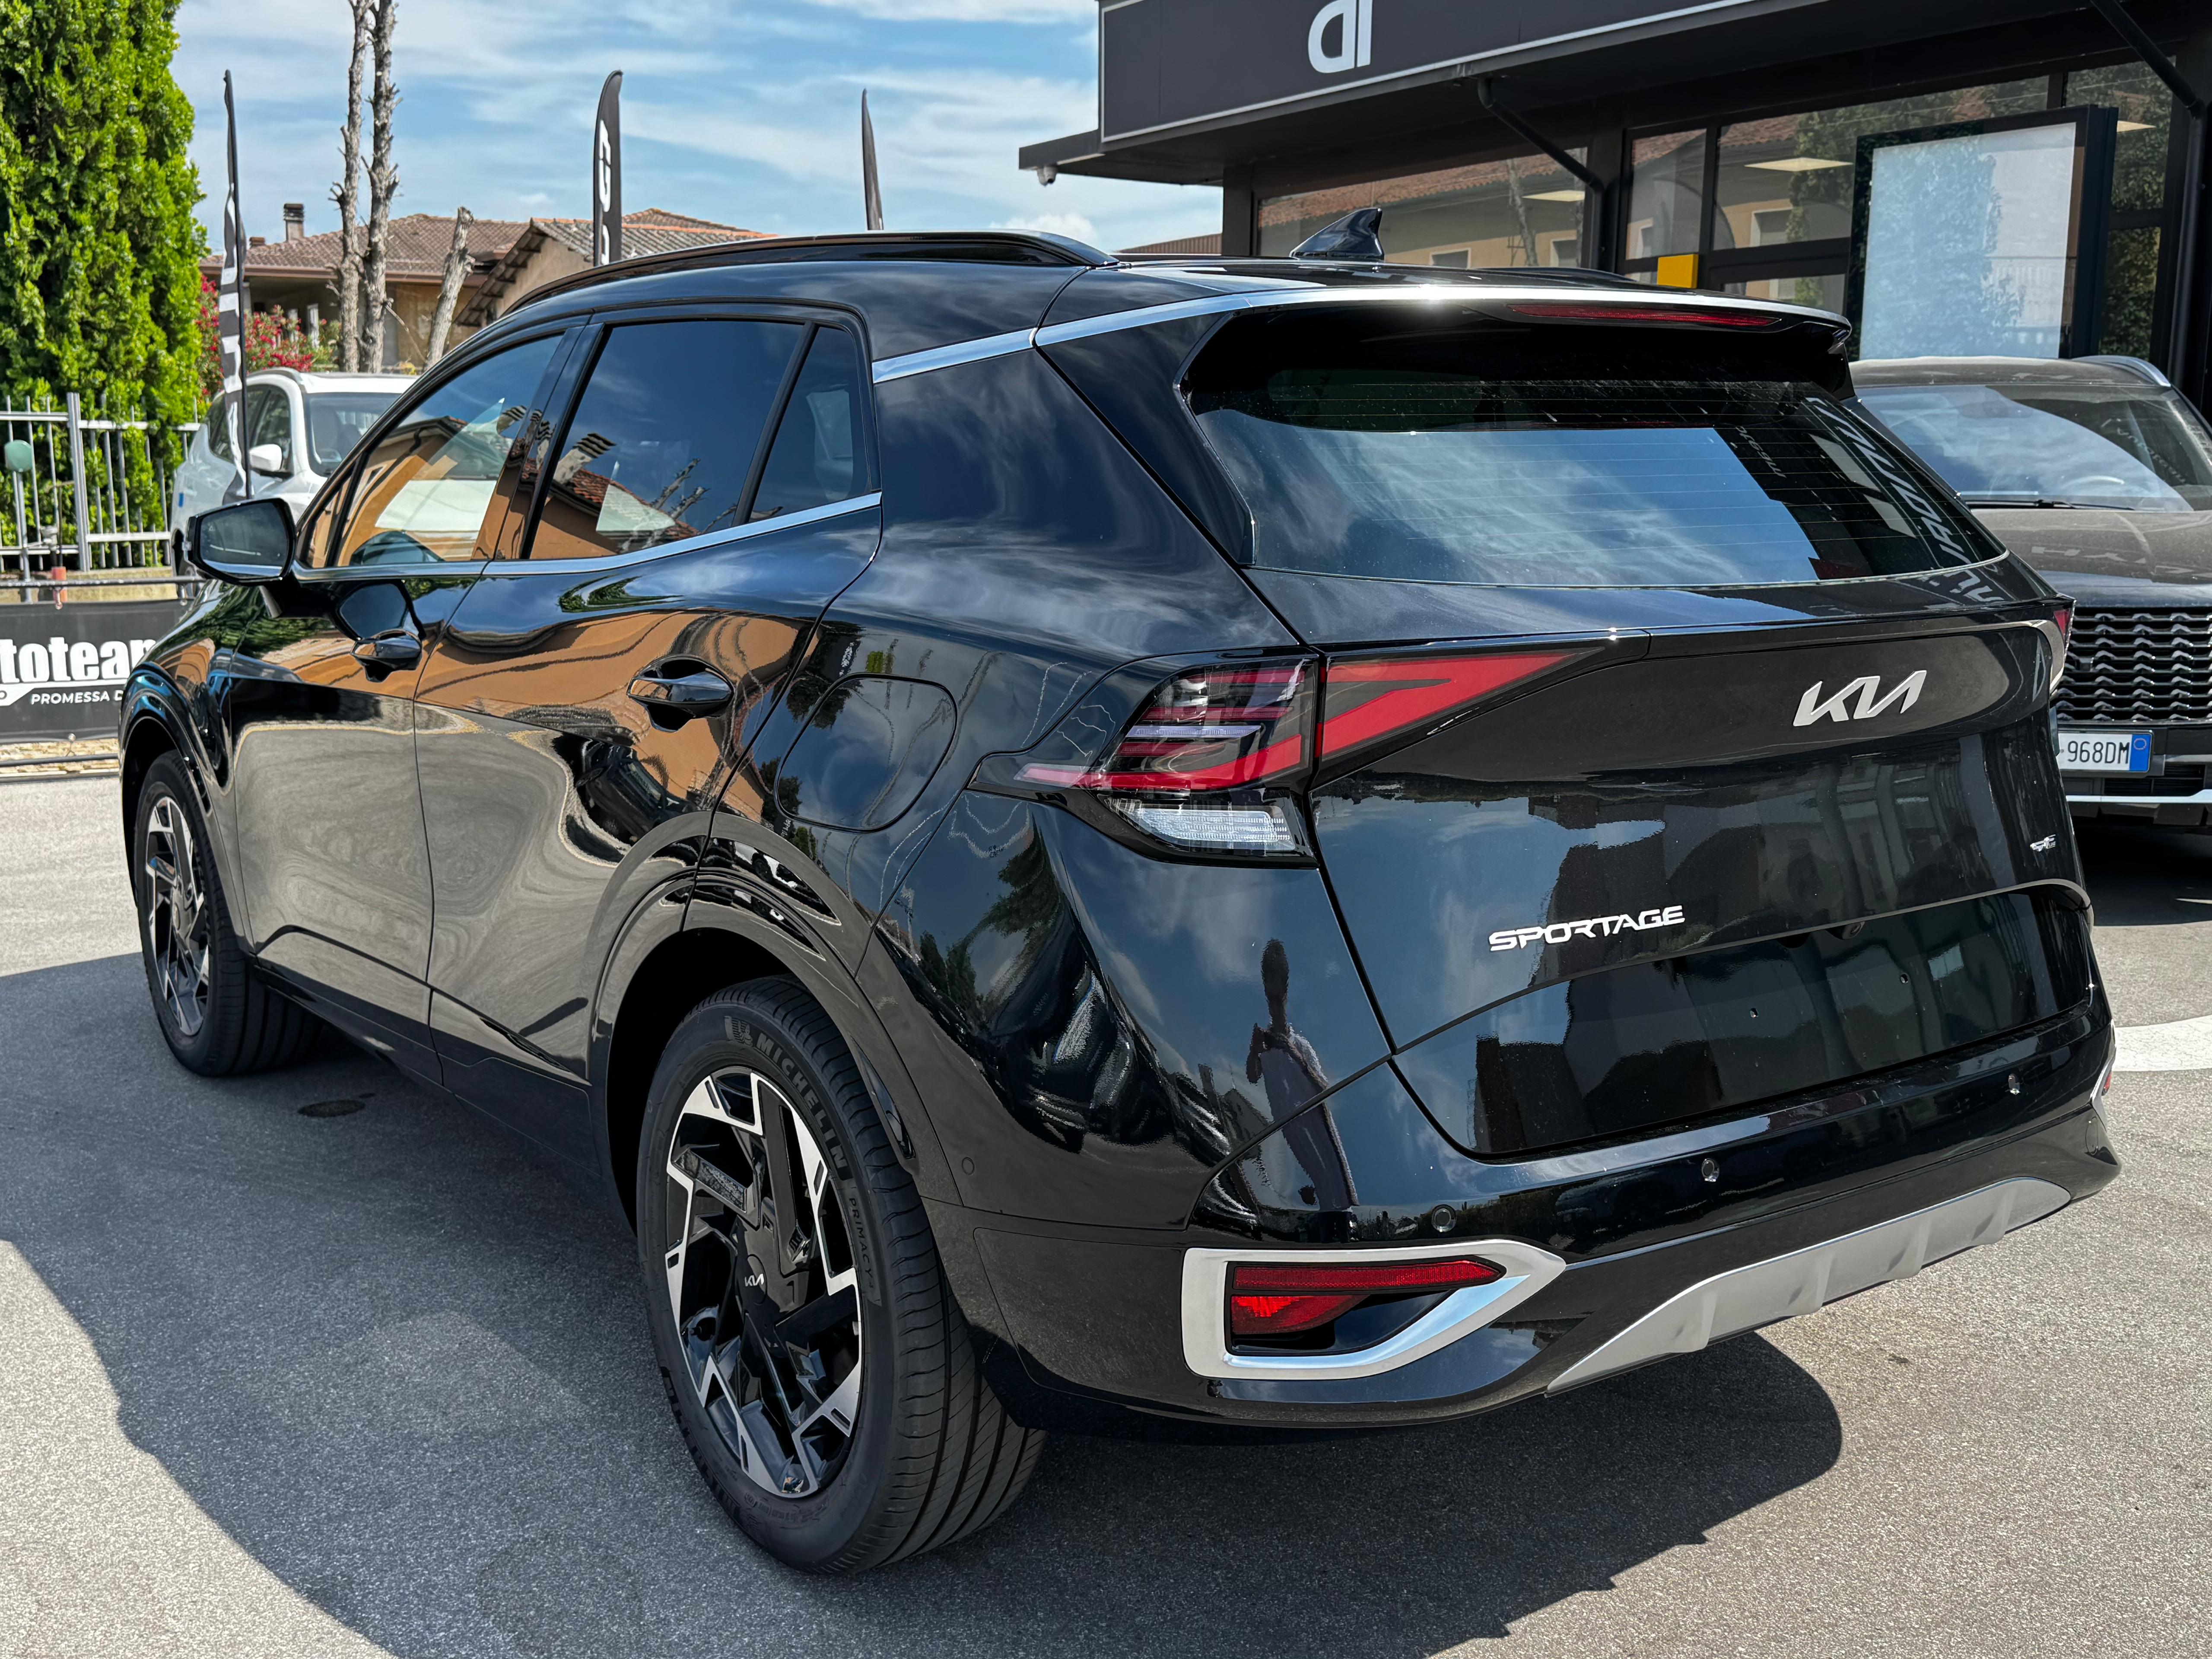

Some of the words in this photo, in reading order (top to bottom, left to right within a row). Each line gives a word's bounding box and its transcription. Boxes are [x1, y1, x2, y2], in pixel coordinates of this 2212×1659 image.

[31, 691, 110, 705] PROMESSA
[1793, 670, 1927, 727] KIA
[2067, 741, 2130, 764] 968DM
[1488, 905, 1685, 951] SPORTAGE
[756, 1032, 849, 1169] MICHELIN
[849, 1198, 873, 1278] PRIMACY
[744, 1273, 765, 1287] KIA
